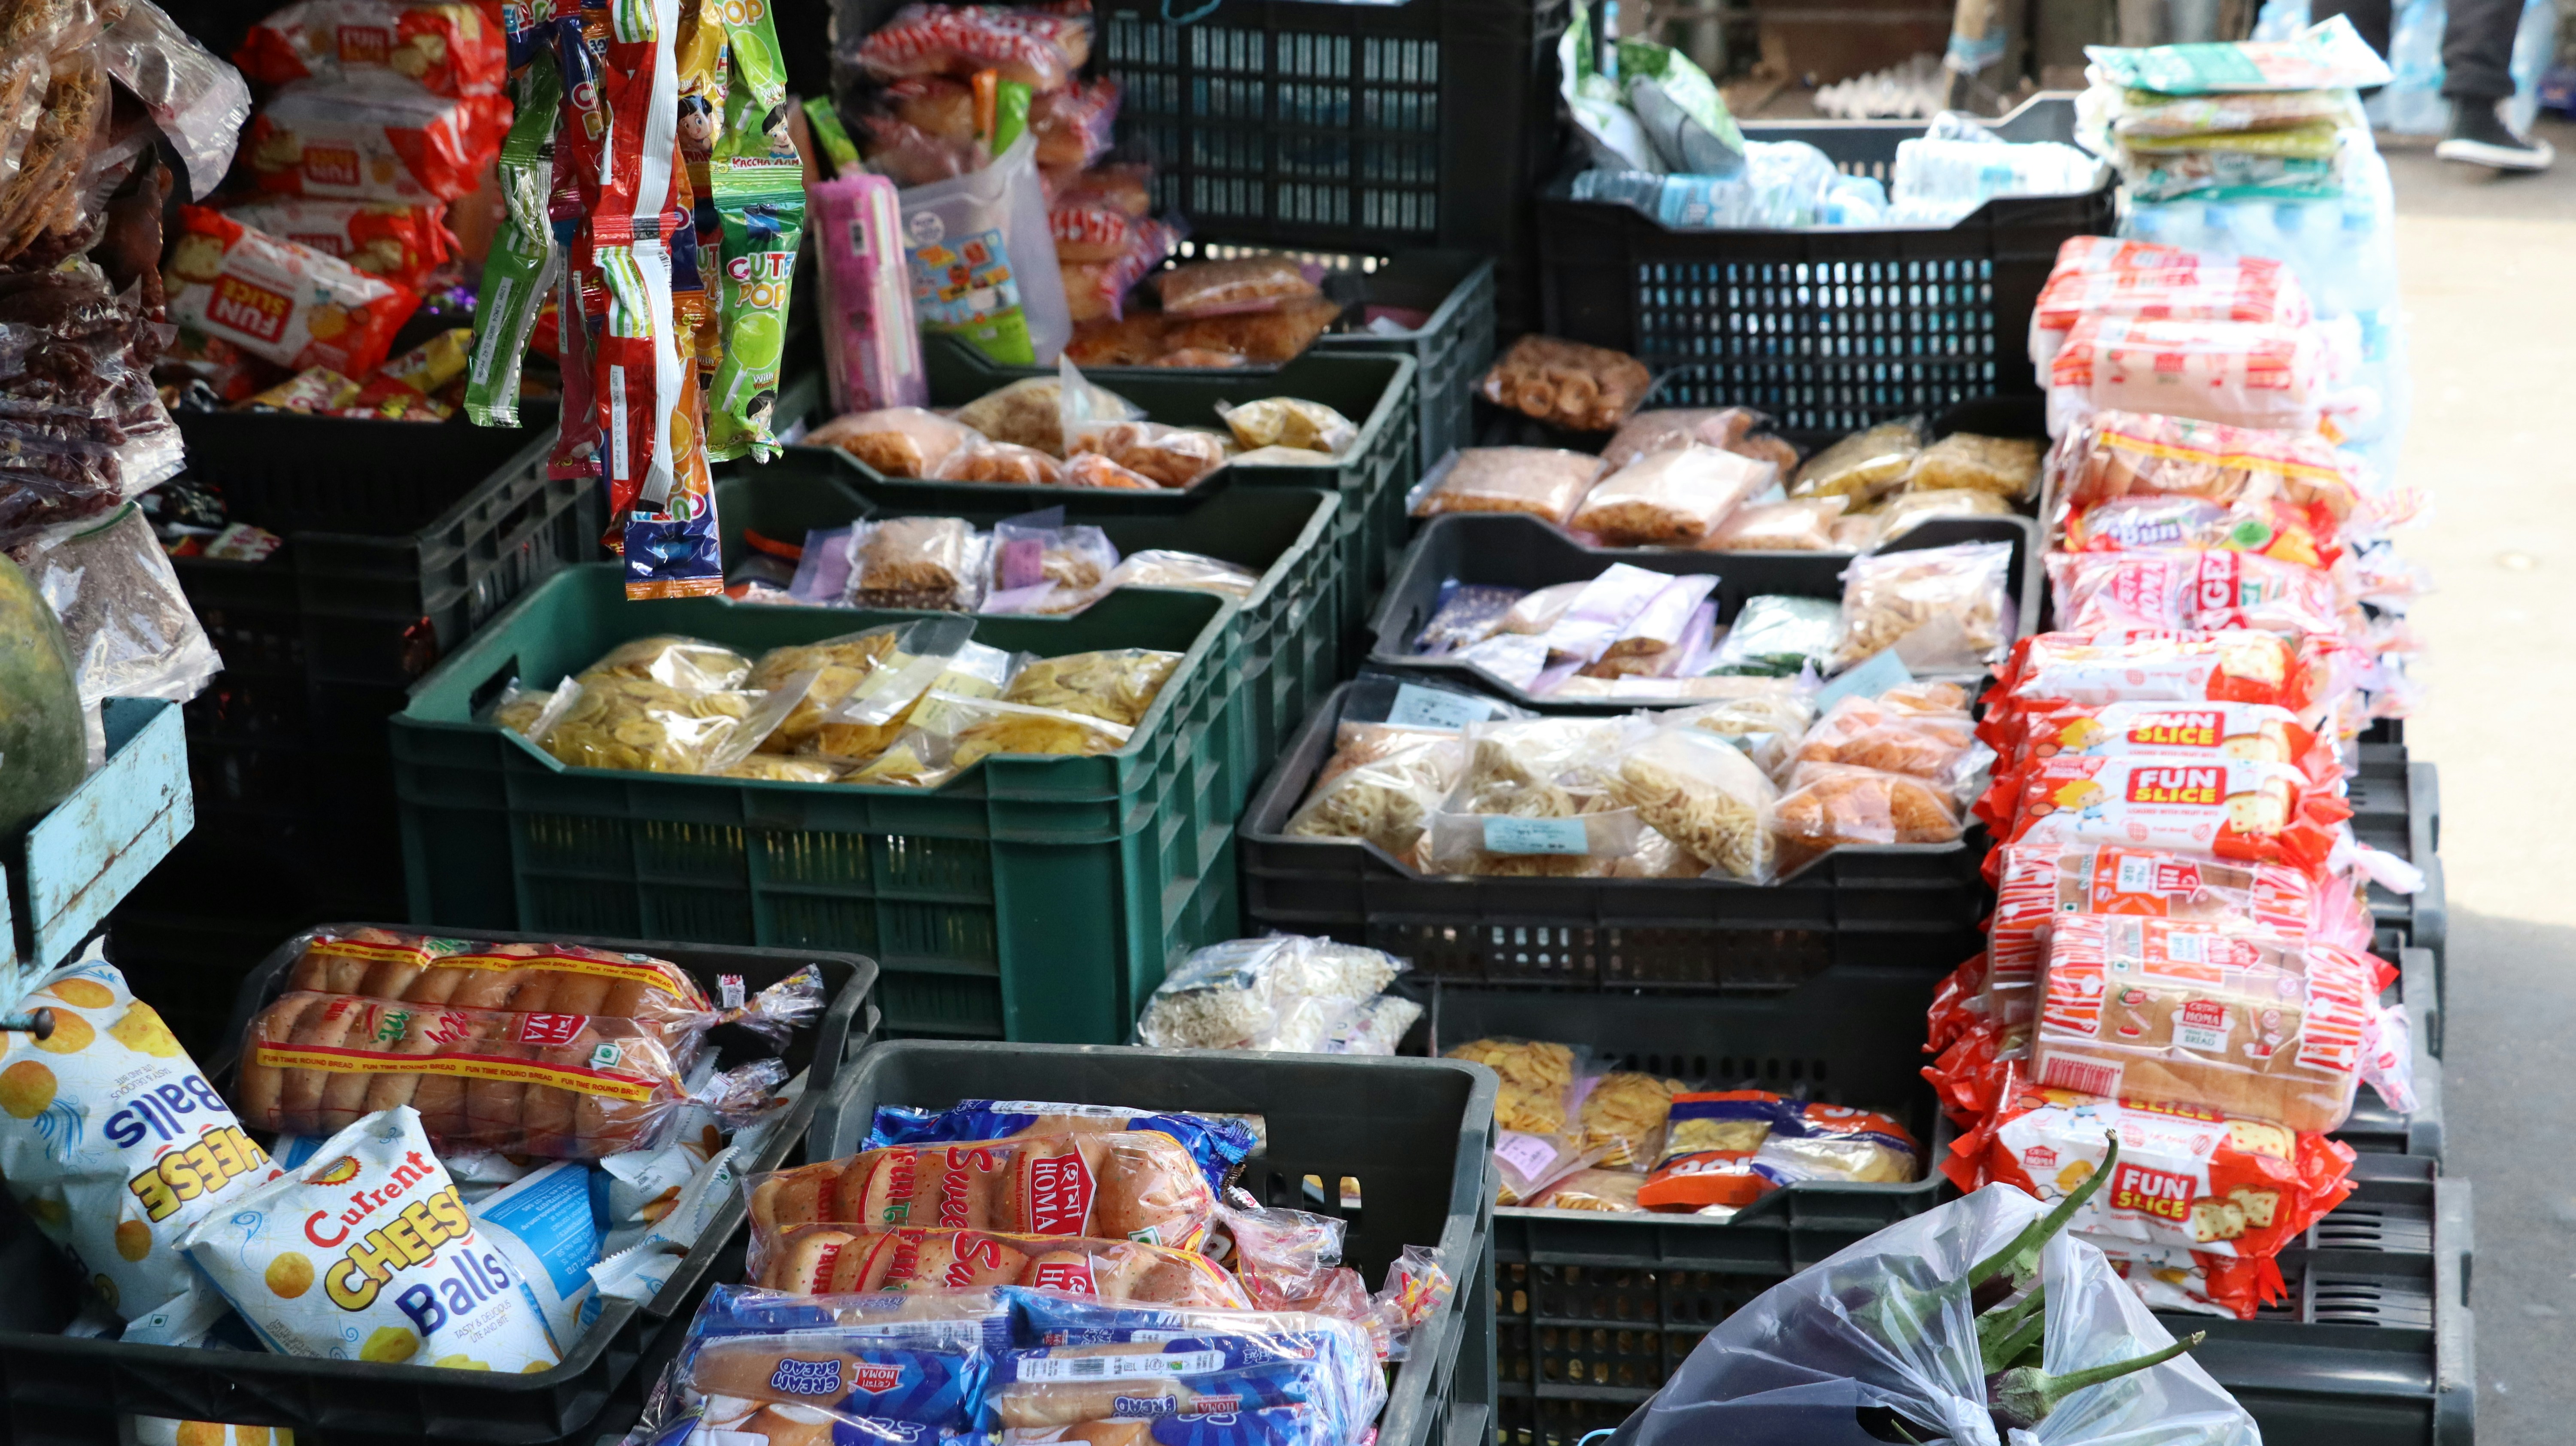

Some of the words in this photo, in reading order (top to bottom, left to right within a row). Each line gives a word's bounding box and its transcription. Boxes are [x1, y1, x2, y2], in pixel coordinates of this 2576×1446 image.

[732, 157, 771, 169] KACCHA
[774, 158, 799, 167] AAM
[627, 259, 642, 287] NUTRITIONAL
[728, 252, 796, 280] CUTE
[220, 278, 288, 316] SLICE
[736, 283, 787, 309] POP
[215, 298, 279, 336] FUN
[752, 373, 774, 383] With
[2136, 711, 2217, 729] FUN
[2135, 728, 2215, 745] SLICE
[2138, 769, 2217, 789] FUN
[2134, 788, 2217, 803] SLICE
[621, 969, 647, 978] ROUND
[648, 975, 672, 988] BREAD
[2185, 1011, 2220, 1026] HOMA
[2185, 1035, 2215, 1046] BREAD
[114, 1074, 130, 1086] BITE
[128, 1068, 143, 1078] AND
[152, 1067, 172, 1079] TASTY
[301, 1058, 327, 1066] ROUND
[328, 1060, 353, 1069] BREAD
[499, 1068, 526, 1078] ROUND
[529, 1071, 553, 1081] BREAD
[561, 1077, 574, 1086] FUN
[576, 1081, 590, 1089] TIME
[592, 1083, 619, 1093] ROUND
[110, 1077, 148, 1100] DELICIOUS
[103, 1073, 229, 1149] Balls
[128, 1124, 270, 1224] HEESE
[884, 1149, 918, 1199] Fun
[2121, 1168, 2189, 1200] FUN
[304, 1150, 435, 1248] Current
[1034, 1163, 1058, 1231] HOMA
[1060, 1157, 1083, 1219] হোমা
[2117, 1191, 2186, 1218] SLICE
[325, 1184, 474, 1312] CHEES
[884, 1228, 927, 1279] Fun
[565, 1261, 577, 1276] LTD.
[394, 1248, 509, 1339] Balls
[454, 1321, 475, 1339] TASTY
[475, 1318, 483, 1327] &
[481, 1300, 511, 1323] DELICIOUS
[483, 1322, 497, 1335] AND
[496, 1314, 509, 1327] BITE
[779, 1358, 841, 1377] BREAD
[862, 1369, 895, 1379] HOMA
[771, 1370, 841, 1395] CREAM
[1113, 1395, 1177, 1414] BREAD
[1200, 1402, 1235, 1413] HOMA
